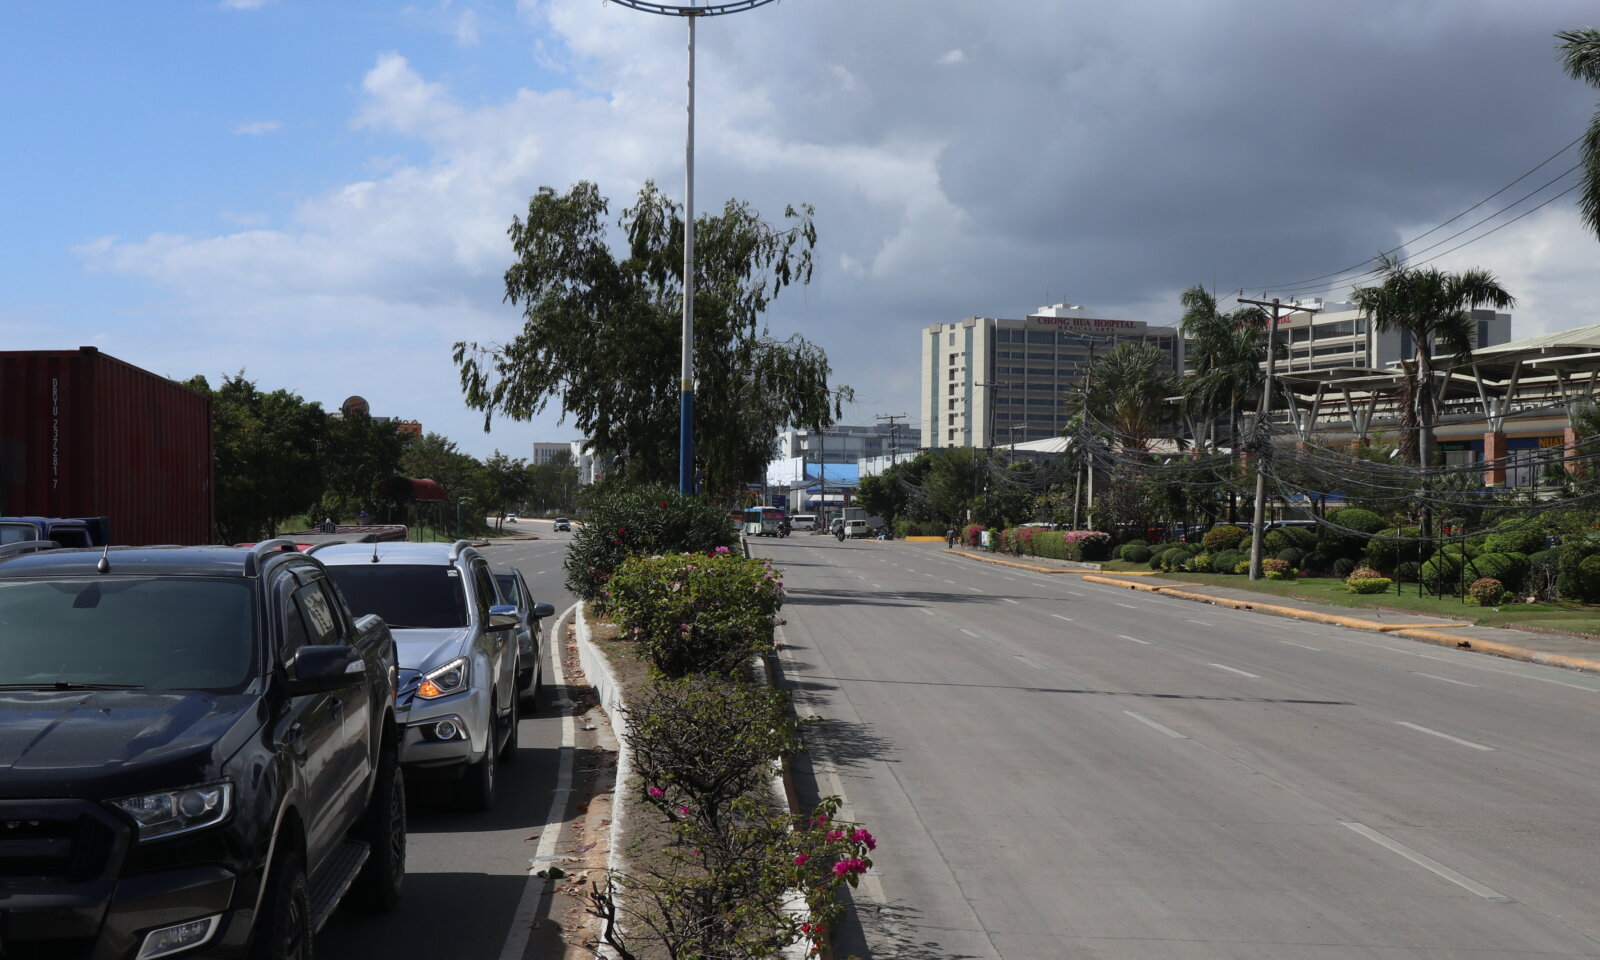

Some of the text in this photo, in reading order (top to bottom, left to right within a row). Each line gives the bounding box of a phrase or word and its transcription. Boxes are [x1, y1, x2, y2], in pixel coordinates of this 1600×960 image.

[1037, 317, 1136, 328] CHONG HUA HOSPITAL
[52, 479, 58, 489] 7
